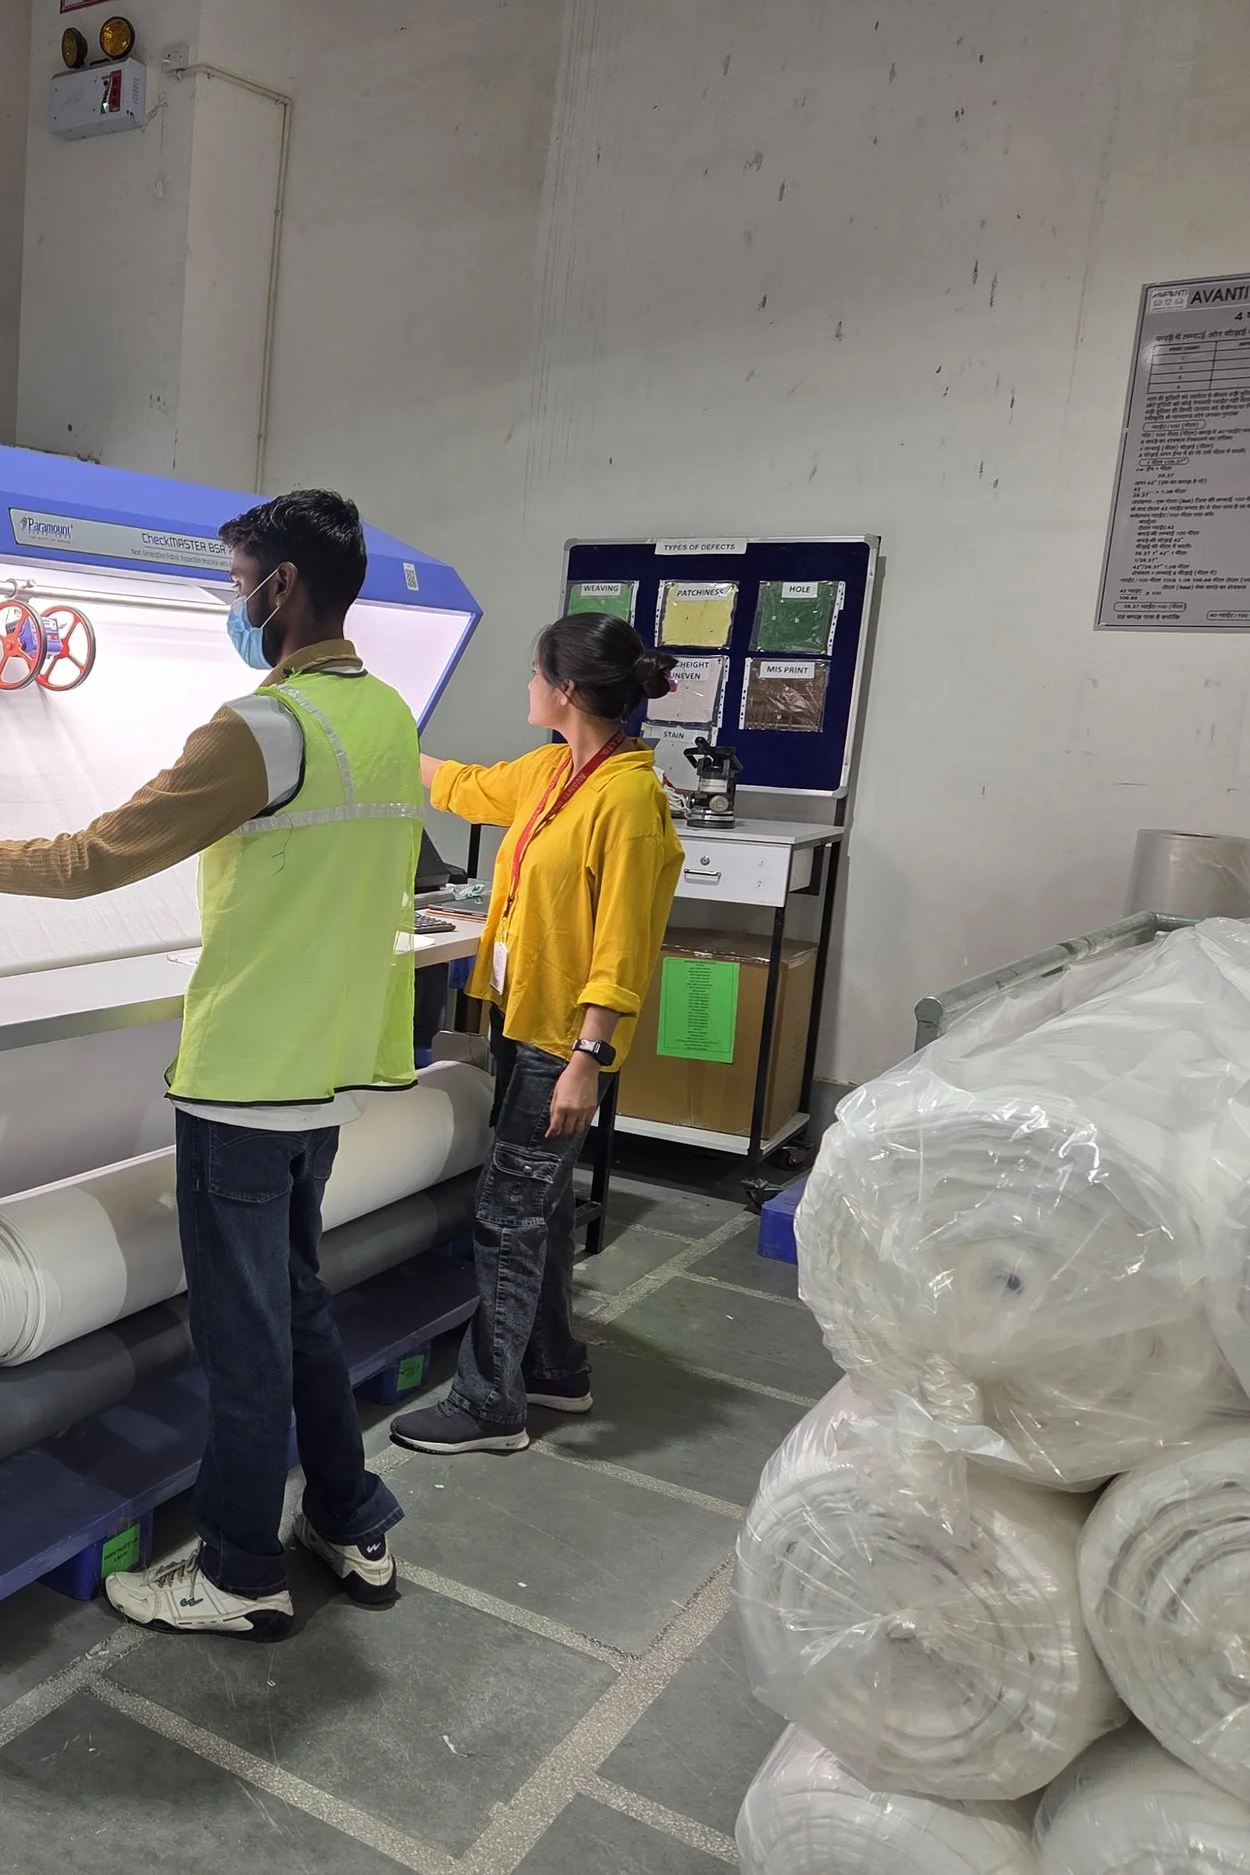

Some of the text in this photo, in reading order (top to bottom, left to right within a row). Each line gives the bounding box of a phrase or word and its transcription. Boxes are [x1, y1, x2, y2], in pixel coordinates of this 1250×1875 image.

[663, 543, 735, 552] TYPES OF DEFECTS
[583, 584, 619, 592] WEAVING
[789, 585, 811, 594] HOLE
[680, 661, 709, 669] HEIGHT
[766, 665, 809, 675] MIS PRINT
[663, 731, 685, 739] STAIN
